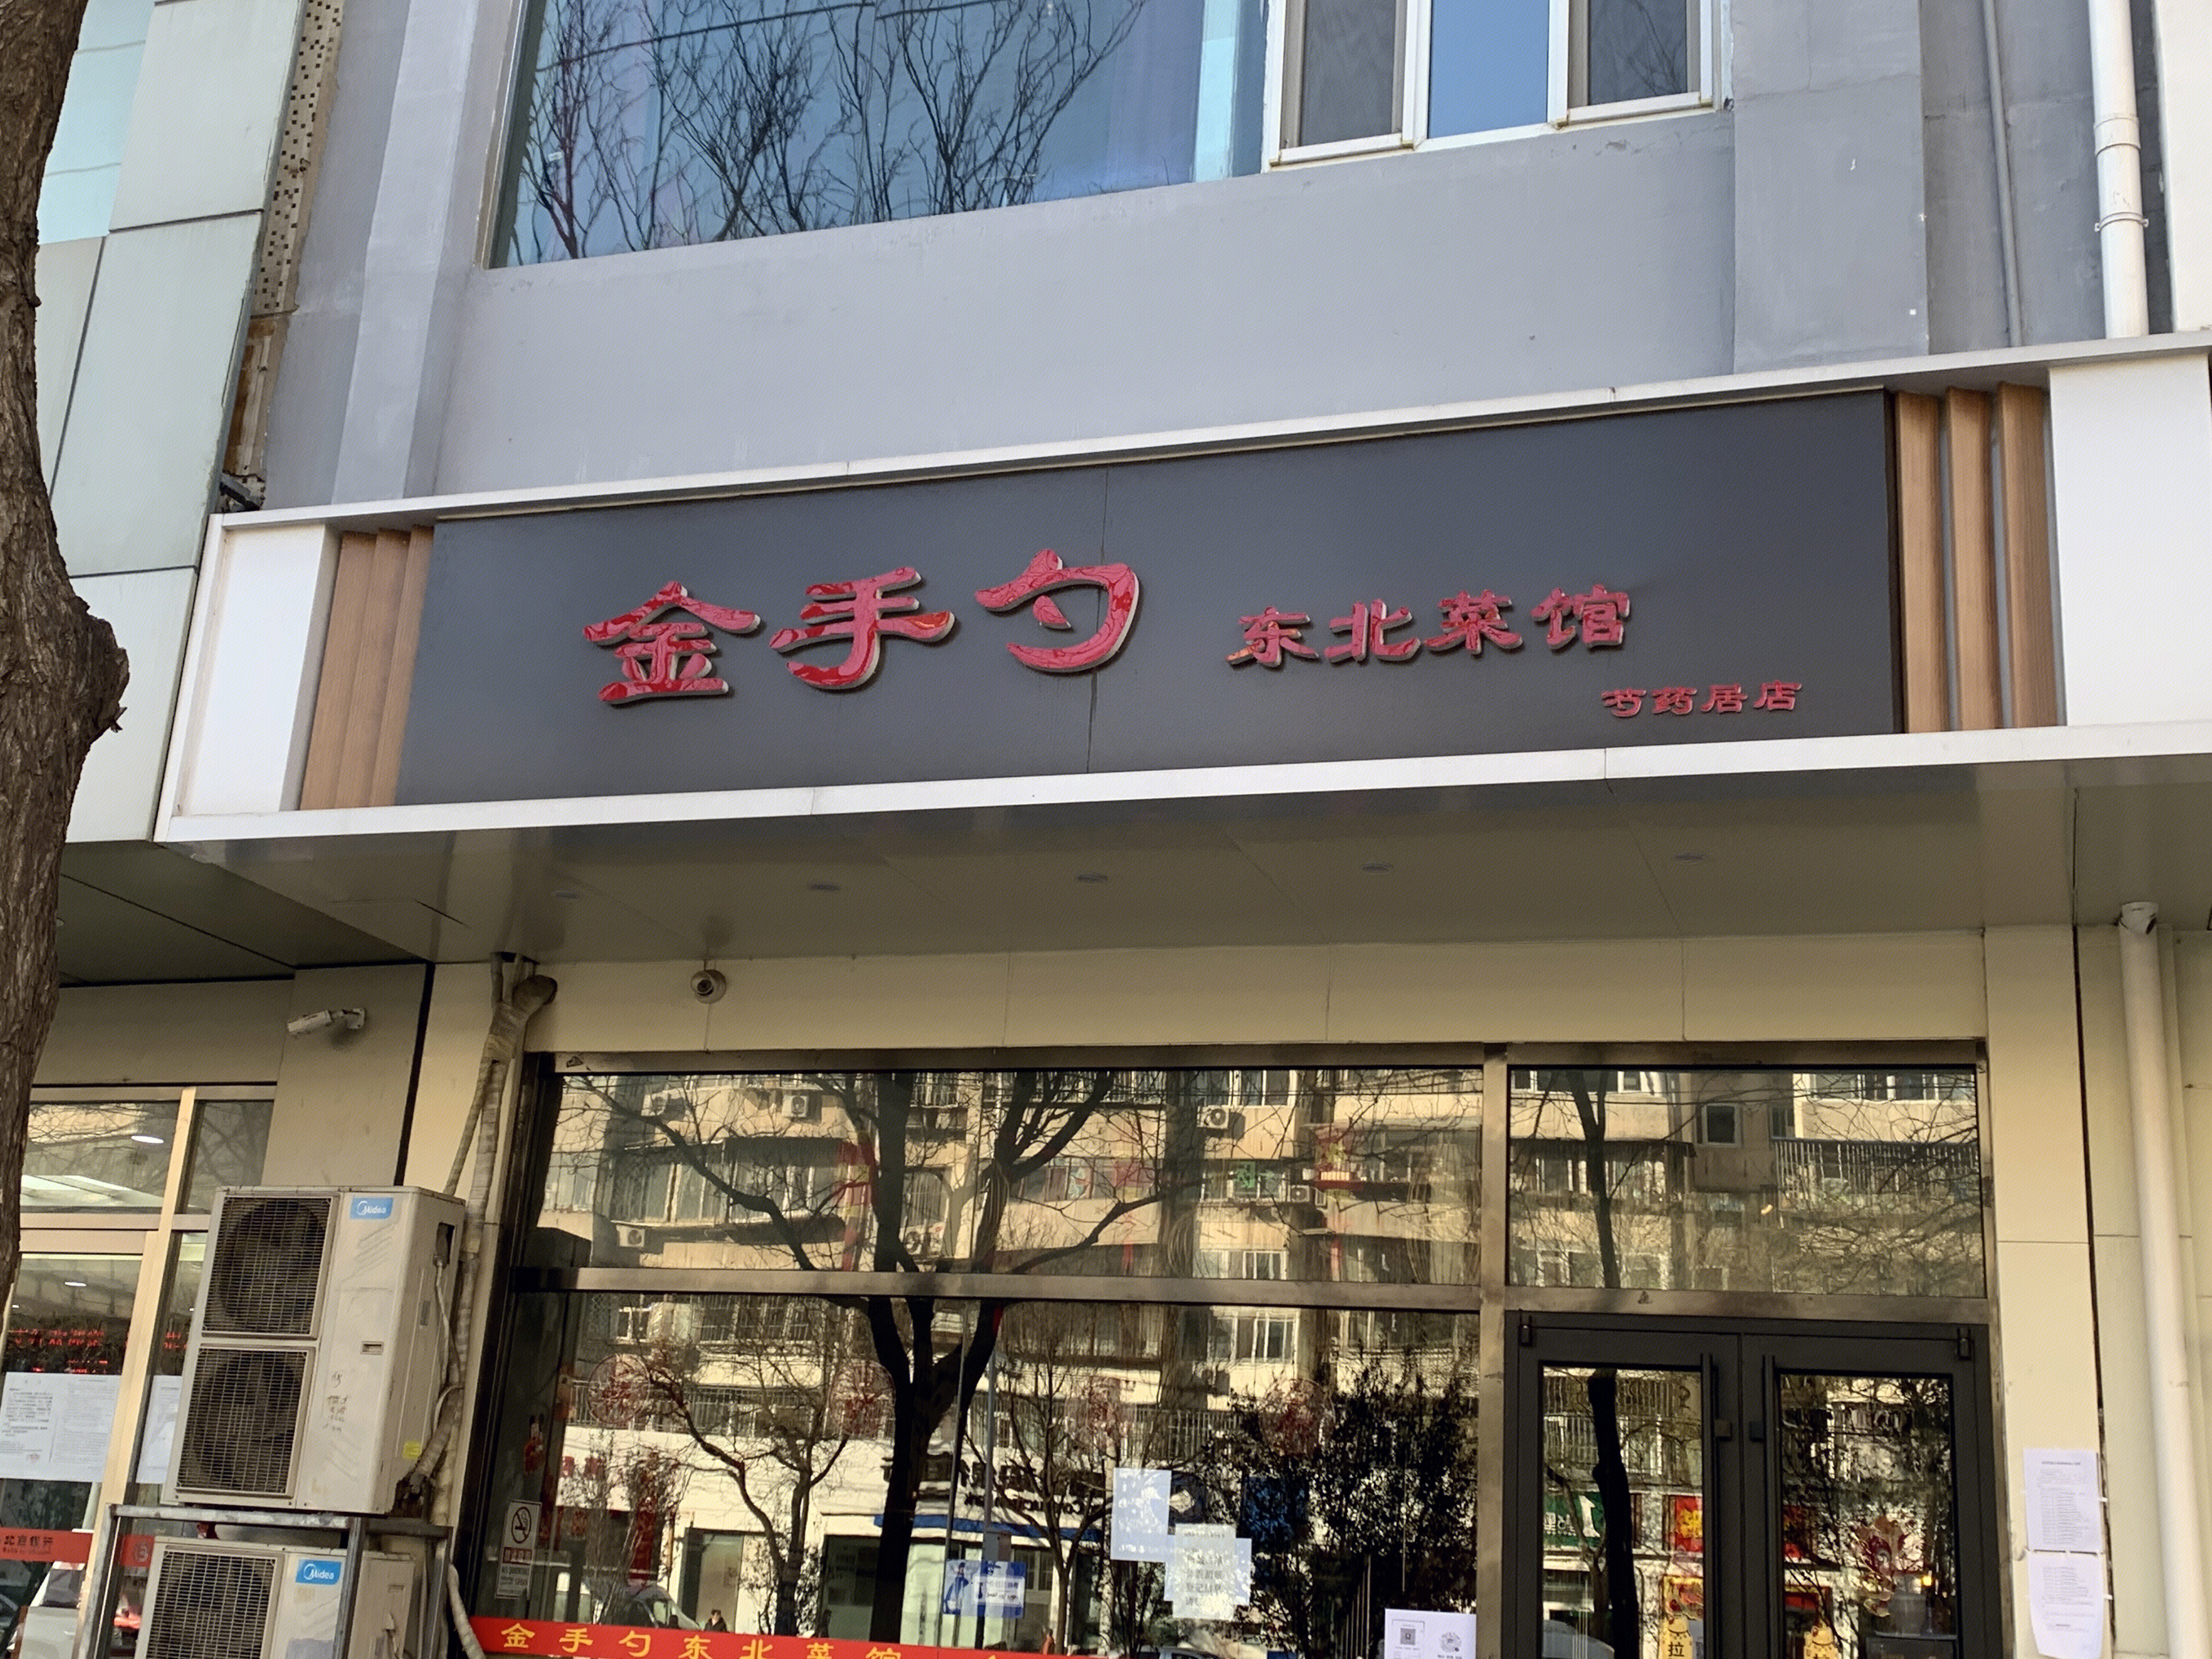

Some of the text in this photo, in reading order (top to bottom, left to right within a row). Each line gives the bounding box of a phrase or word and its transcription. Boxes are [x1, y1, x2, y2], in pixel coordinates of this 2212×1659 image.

[583, 549, 1139, 705] 金手勺
[1226, 583, 1631, 668] 东北菜馆
[1601, 680, 1802, 718] 芍药居店
[357, 1200, 387, 1216] Midea
[303, 1563, 334, 1580] Midea
[1668, 1641, 1685, 1657] 拉
